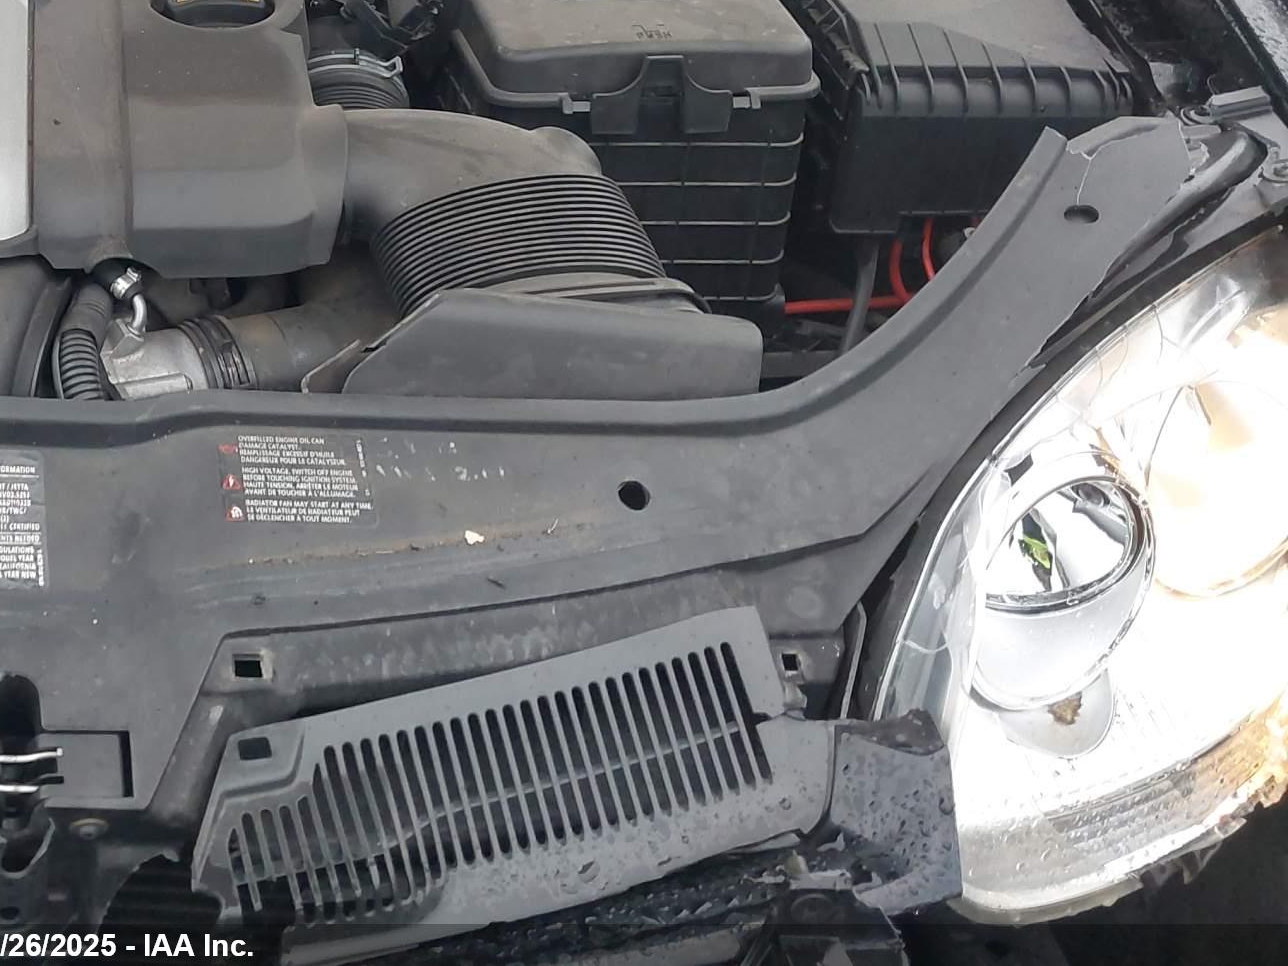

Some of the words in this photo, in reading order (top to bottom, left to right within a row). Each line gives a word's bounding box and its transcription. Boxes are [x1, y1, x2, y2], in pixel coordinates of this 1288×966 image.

[292, 468, 316, 476] SWITCH
[245, 488, 266, 496] AVANT
[278, 489, 306, 497] TOUCHER
[9, 523, 40, 531] CERTIFIED
[17, 554, 34, 562] YEAR
[0, 562, 36, 570] CALIFORNIA
[4, 570, 20, 578] YEAR
[21, 570, 36, 578] NEW
